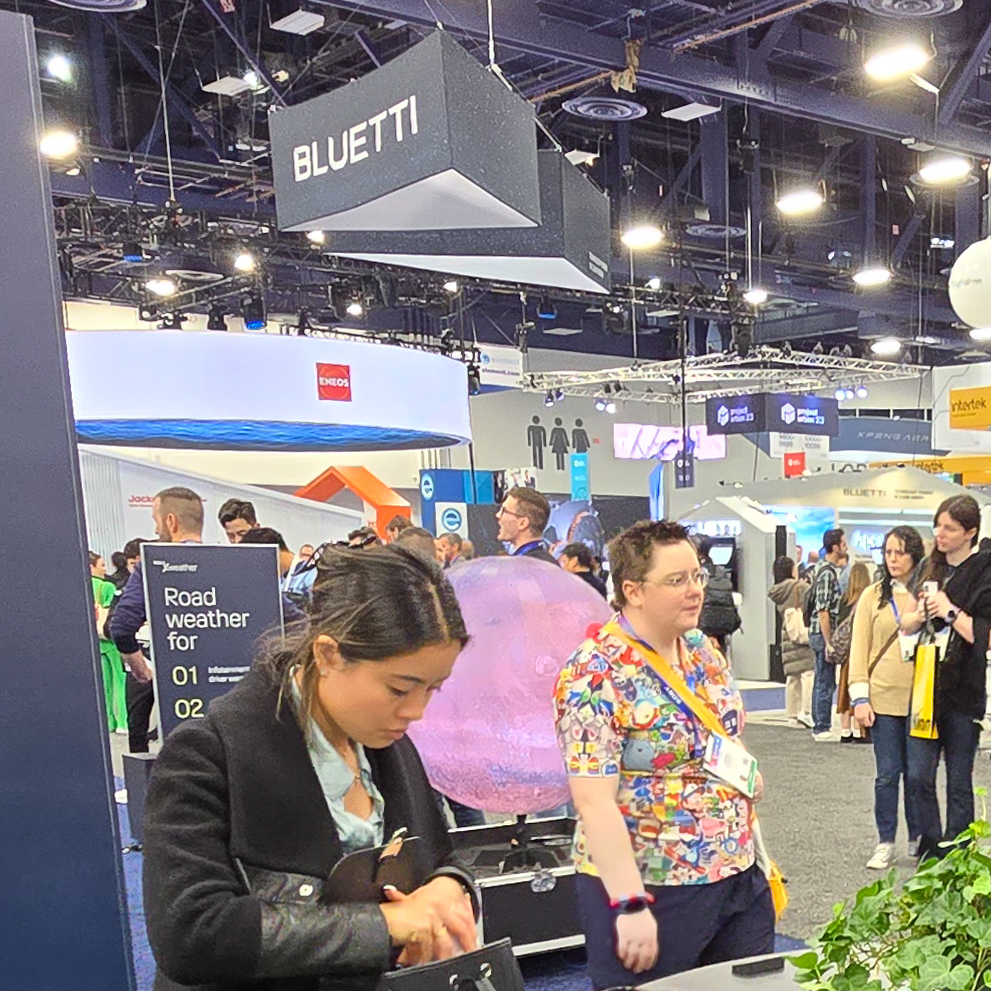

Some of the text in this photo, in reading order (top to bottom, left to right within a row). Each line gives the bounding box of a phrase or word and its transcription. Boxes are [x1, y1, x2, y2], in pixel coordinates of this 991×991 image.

[293, 95, 418, 182] BLUETTI
[318, 376, 349, 388] ENEOS
[843, 487, 886, 497] BLUETTI
[164, 587, 217, 606] Road
[165, 609, 249, 629] weather
[167, 631, 198, 651] for
[172, 666, 198, 685] 01
[174, 699, 204, 718] 02
